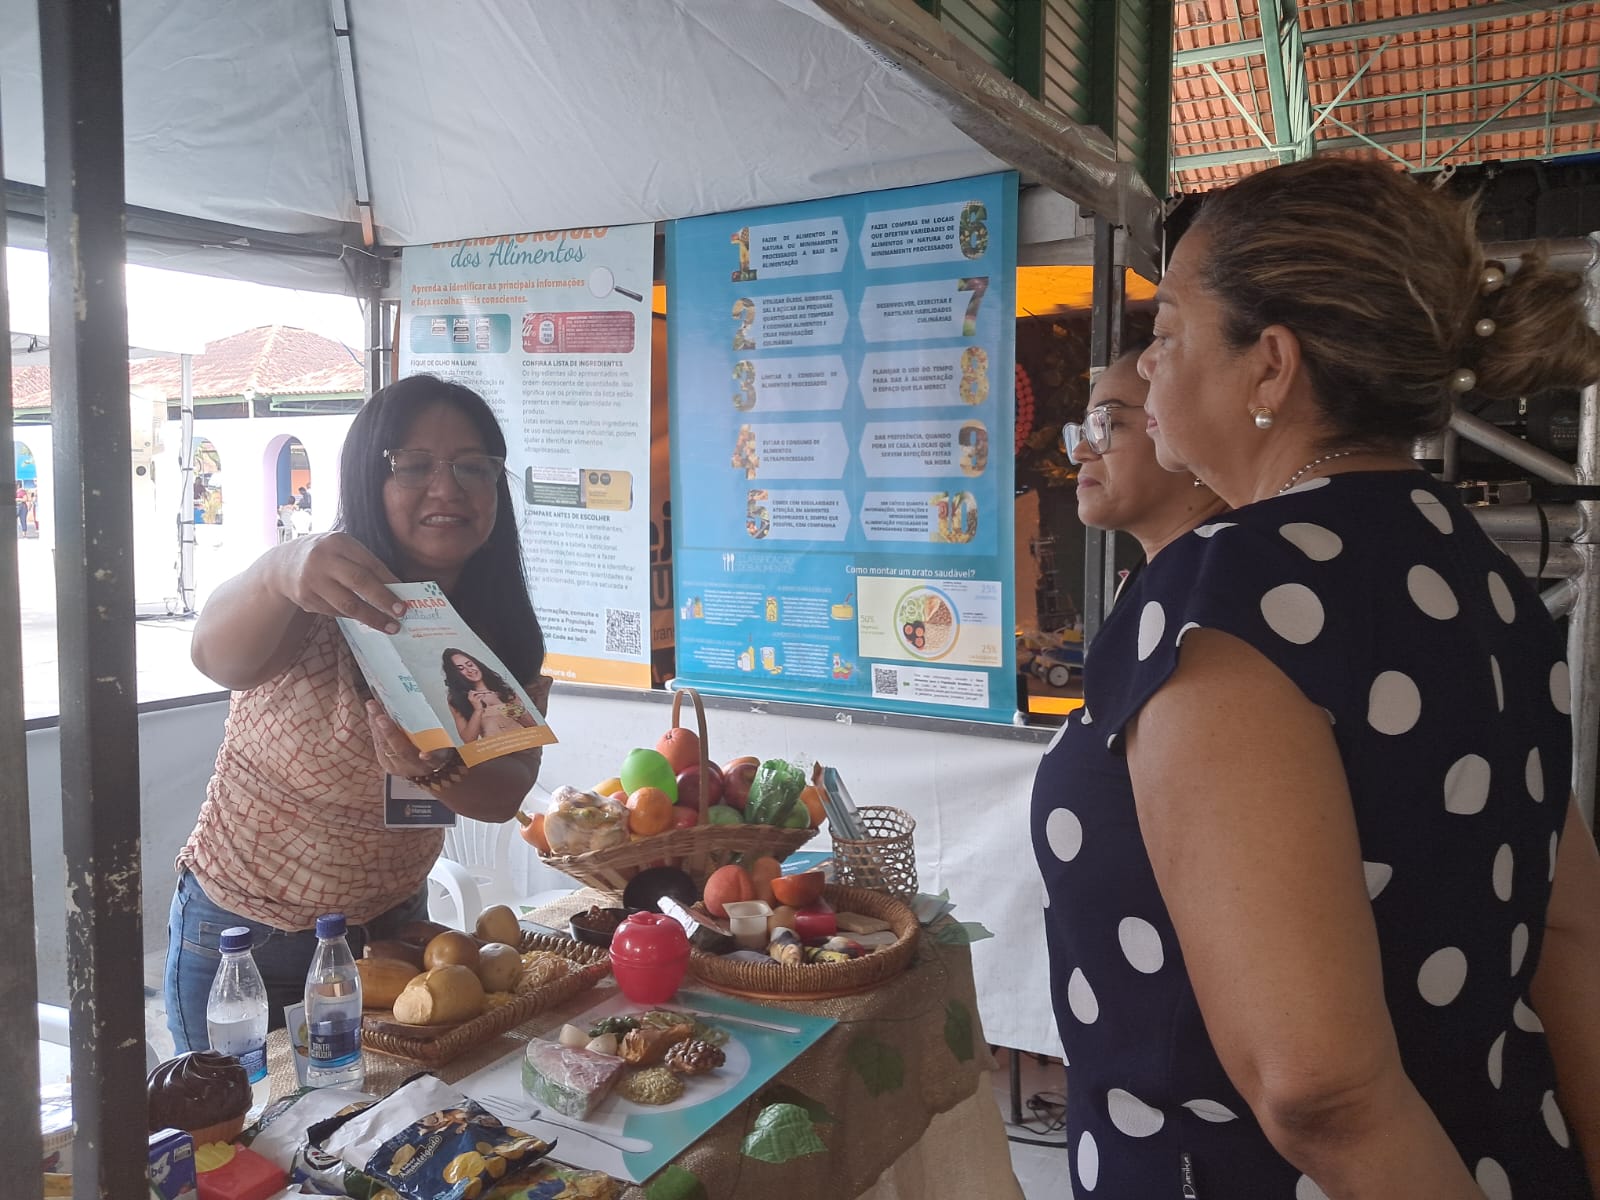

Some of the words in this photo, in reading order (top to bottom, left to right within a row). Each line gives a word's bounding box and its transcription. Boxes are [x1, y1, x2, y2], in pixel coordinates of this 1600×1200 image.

[870, 223, 888, 231] FAZER
[891, 219, 918, 228] COMPRAS
[870, 232, 882, 240] QUE
[910, 226, 945, 235] VARIEDADES
[959, 200, 988, 260] 6
[870, 240, 904, 248] ALIMENTOS
[917, 235, 941, 243] NATURA
[912, 244, 953, 253] PROCESSADOS
[450, 241, 481, 268] dos
[488, 239, 585, 267] Alimentos
[731, 226, 757, 282] 1
[411, 283, 442, 295] Aprenda
[449, 281, 486, 292] identificar
[498, 280, 535, 292] principais
[536, 278, 585, 290] informações
[957, 276, 989, 337] 7
[579, 360, 624, 368] INGREDIENTES
[911, 373, 953, 381] ALIMENTAÇÃO
[959, 346, 989, 406] 8
[732, 360, 757, 412] 3
[731, 424, 760, 480] 4
[958, 419, 988, 477] 9
[571, 512, 579, 520] DE
[580, 513, 611, 522] ESCOLHER
[746, 489, 770, 540] 5
[845, 565, 868, 574] Como
[869, 567, 896, 575] montar
[934, 568, 976, 579] saudável?
[404, 596, 447, 610] NTAÇÃO
